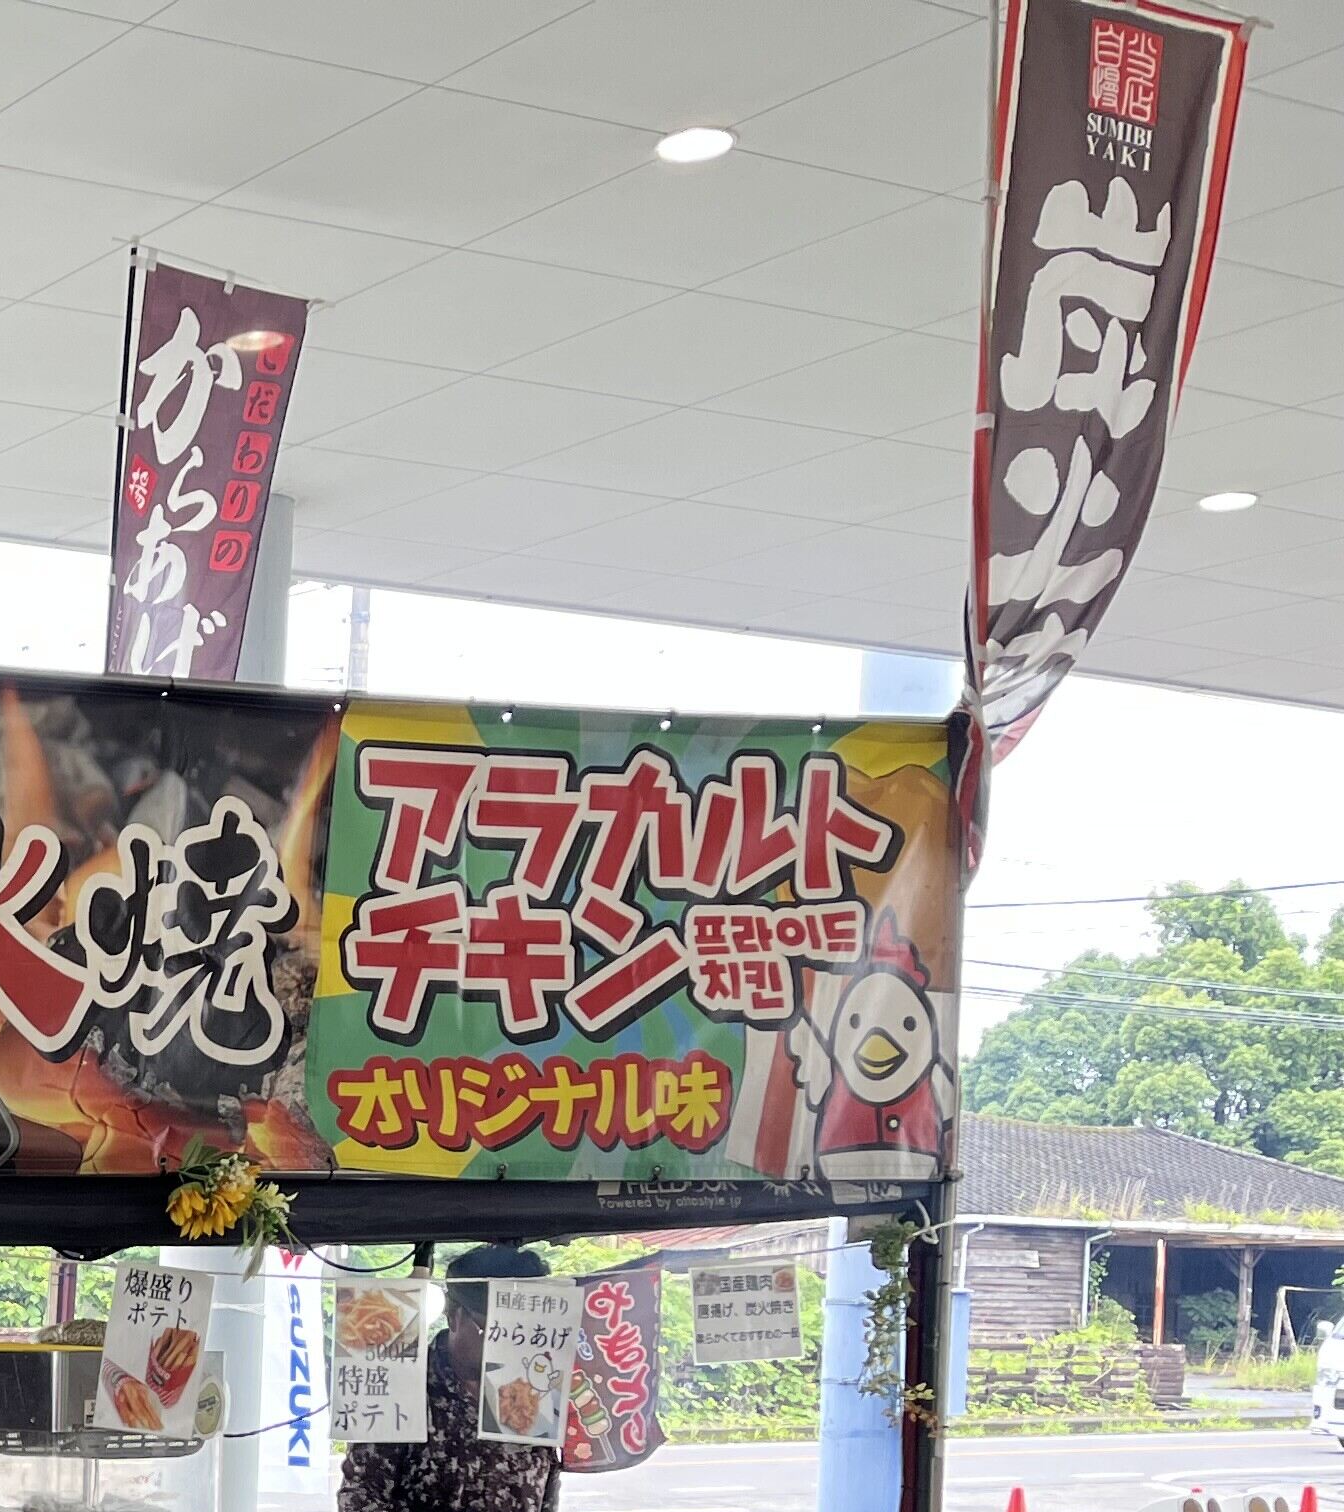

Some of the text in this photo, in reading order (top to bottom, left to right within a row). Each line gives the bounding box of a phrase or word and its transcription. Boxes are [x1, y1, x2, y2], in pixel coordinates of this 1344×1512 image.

[1087, 112, 1153, 149] SUMIBI
[1087, 135, 1151, 172] YAKI
[123, 307, 243, 678] からあげ
[360, 749, 890, 897] アラカルト
[692, 906, 859, 956] 프라이드
[348, 882, 686, 1034] チキン
[702, 956, 786, 1011] 치킨
[334, 1058, 726, 1146] オリジナル味
[125, 1268, 194, 1303] 爆盛り
[496, 1291, 569, 1315] 国産手作り
[128, 1302, 189, 1331] ポテト
[488, 1320, 572, 1351] からあげ
[286, 1283, 311, 1467] SUZUKI
[338, 1364, 389, 1397] 特盛
[334, 1400, 409, 1432] ポテト
